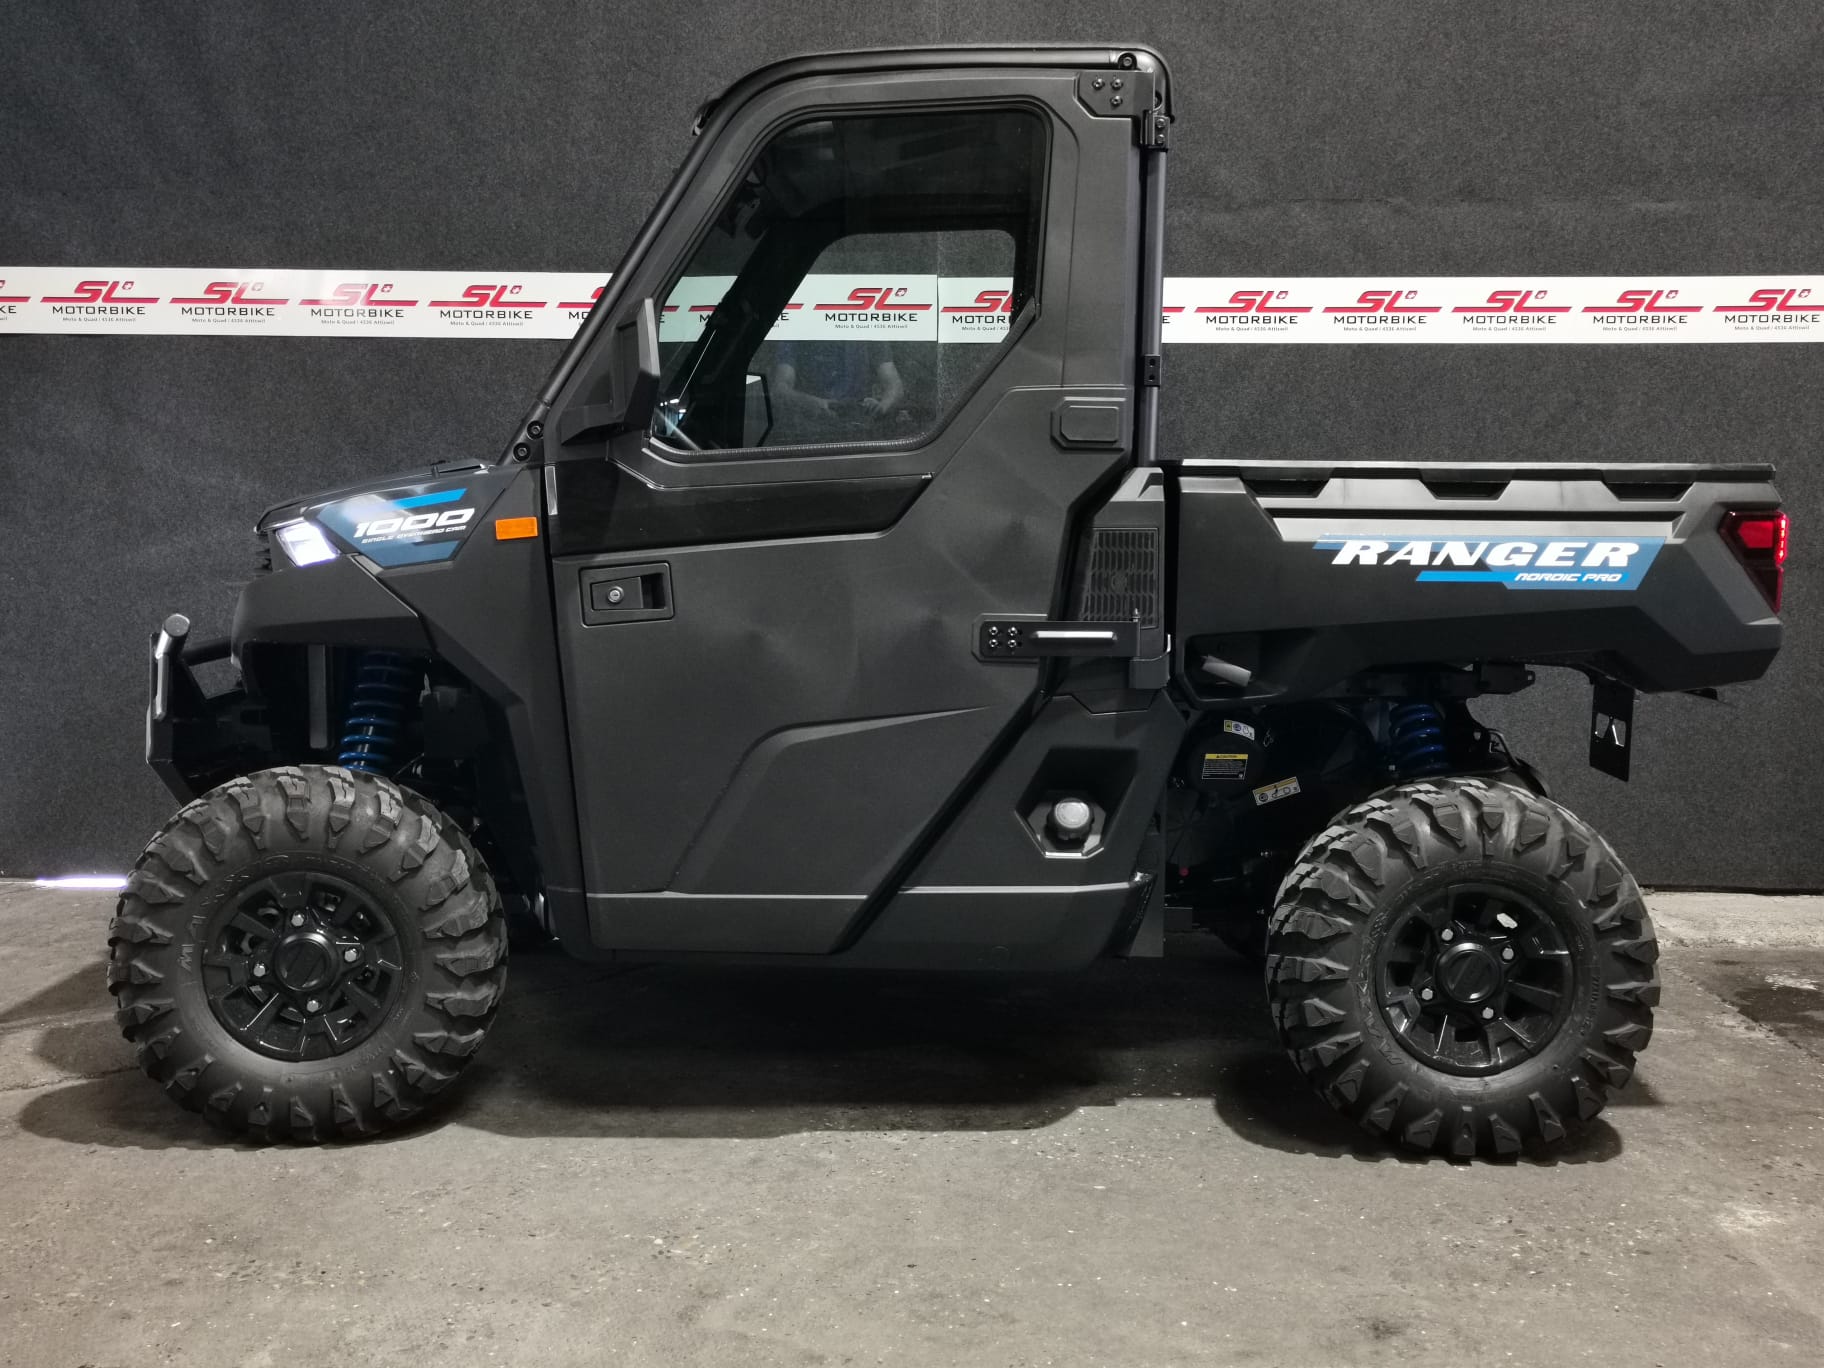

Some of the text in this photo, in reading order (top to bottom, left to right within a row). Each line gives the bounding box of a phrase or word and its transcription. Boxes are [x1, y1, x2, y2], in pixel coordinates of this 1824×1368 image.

[52, 305, 145, 315] MOTORBIKE
[181, 307, 275, 316] MOTORBIKE
[310, 308, 404, 318] MOTORBIKE
[440, 310, 533, 319] MOTORBIKE
[825, 313, 918, 322] MOTORBIKE
[1206, 316, 1298, 324] MOTORBIKE
[1333, 316, 1427, 324] MOTORBIKE
[1463, 316, 1557, 324] MOTORBIKE
[1593, 315, 1688, 324] MOTORBIKE
[1724, 314, 1820, 323] MOTORBIKE
[353, 507, 475, 538] 1000
[1331, 540, 1639, 567] RANGER
[1580, 572, 1623, 582] PRO
